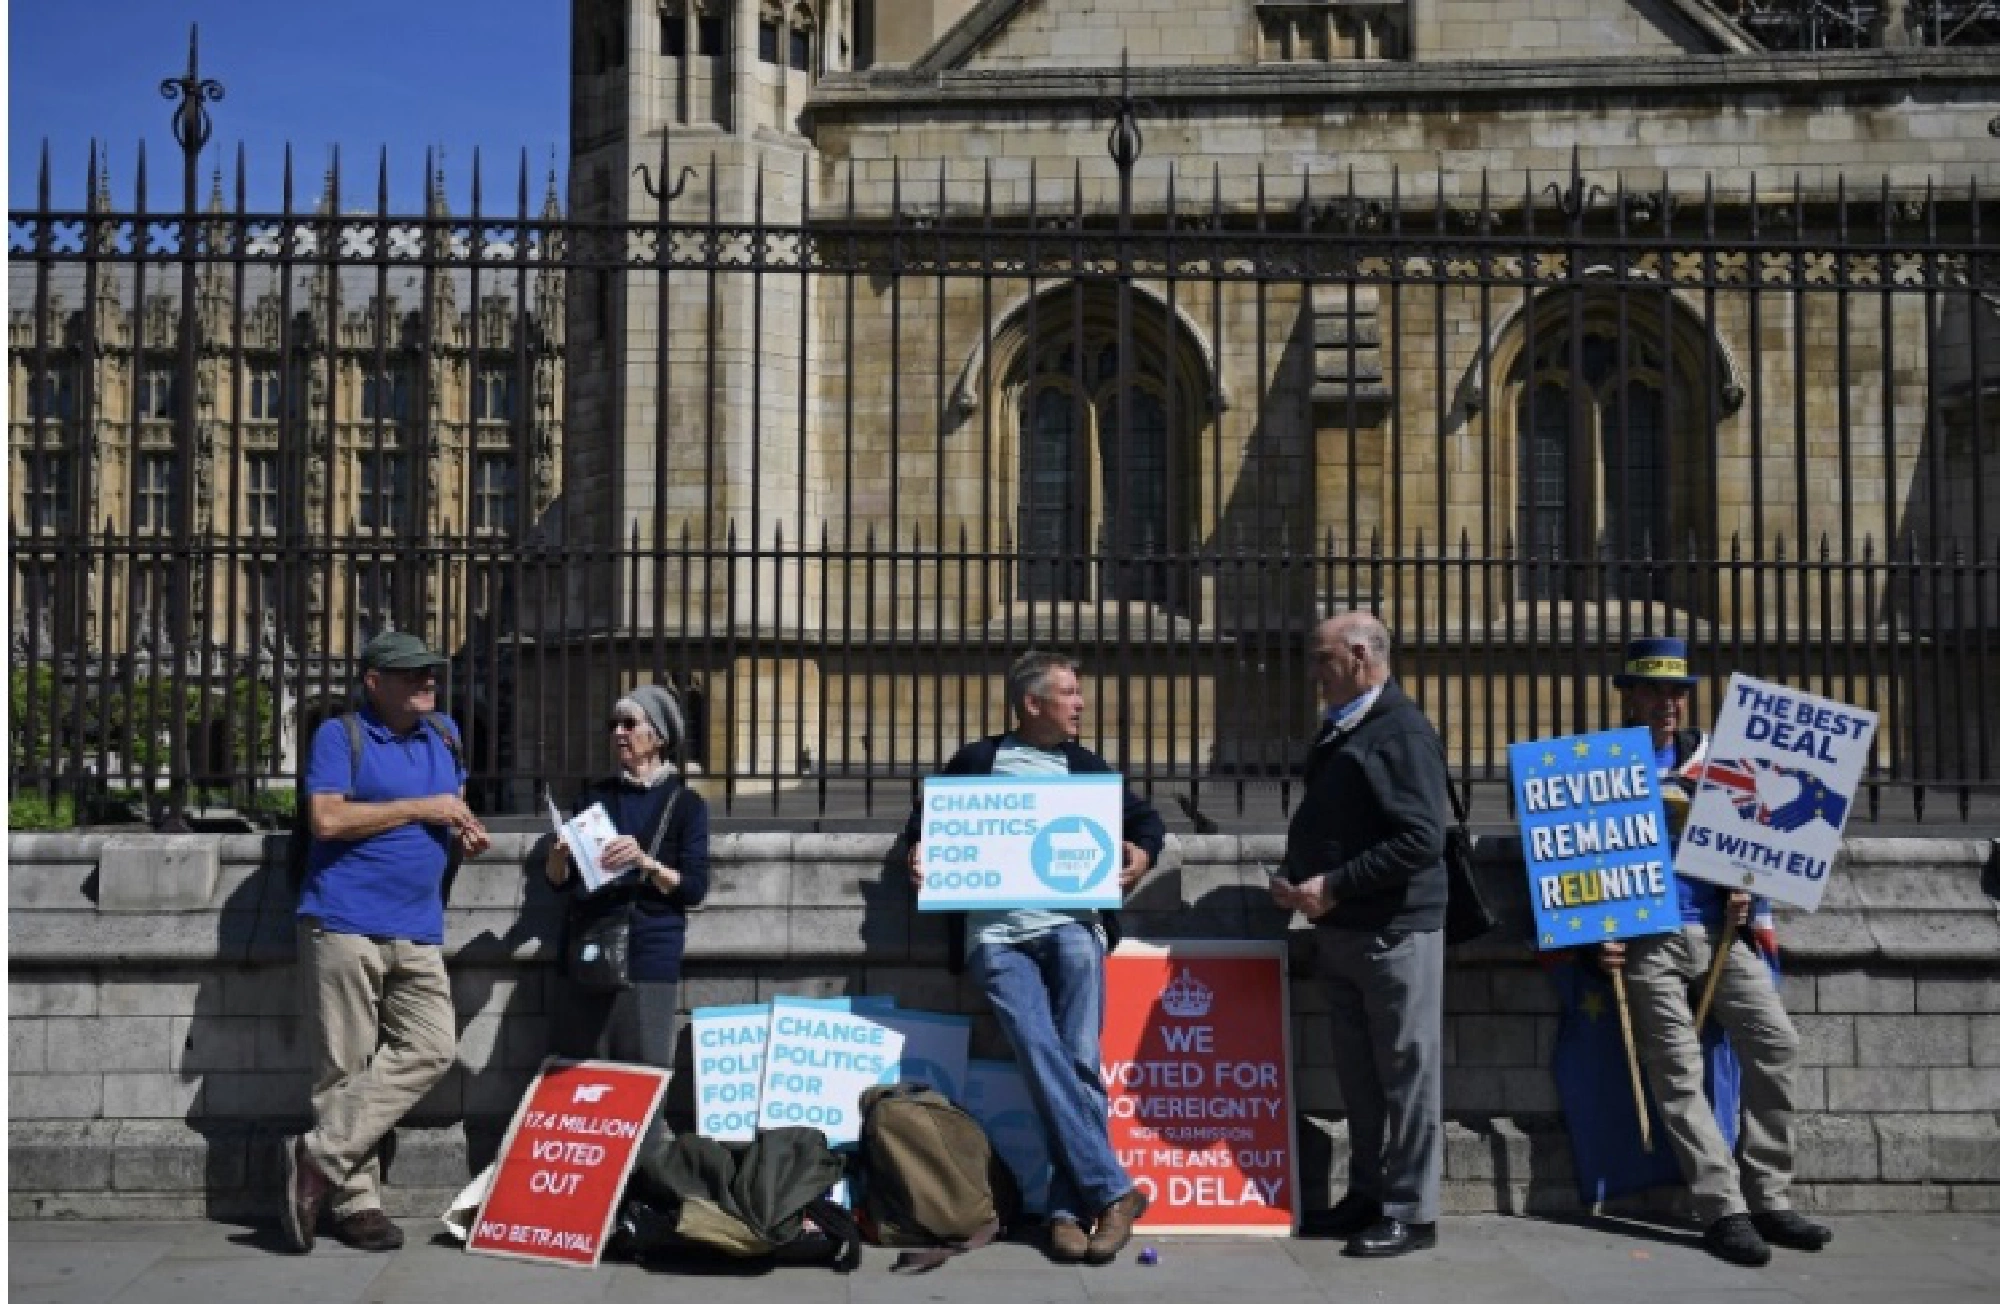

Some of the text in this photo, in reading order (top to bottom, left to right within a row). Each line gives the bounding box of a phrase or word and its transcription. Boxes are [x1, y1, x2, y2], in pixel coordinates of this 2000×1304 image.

[1735, 683, 1870, 741] THE BEST
[1745, 714, 1838, 764] DEAL
[1523, 763, 1650, 812] REVOKE
[930, 793, 1037, 812] CHANGE
[928, 819, 1038, 836] POLITICS
[1530, 811, 1660, 862] REMAIN
[928, 845, 979, 863] FOR
[1686, 824, 1714, 848] IS
[1715, 832, 1784, 869] WITH
[1786, 853, 1828, 883] EU
[926, 870, 1001, 889] GOOD
[1539, 861, 1666, 909] REUNITE
[700, 1026, 768, 1047] CHAN
[777, 1016, 886, 1046] CHANGE
[1159, 1025, 1215, 1053] WE
[701, 1052, 767, 1076] POLI
[773, 1043, 883, 1075] POLITICS
[769, 1071, 823, 1095] FOR
[1099, 1059, 1278, 1089] VOTED FOR
[703, 1082, 756, 1106] FOR
[557, 1113, 638, 1139] MILLION
[704, 1111, 758, 1134] GOO
[767, 1100, 843, 1126] GOOD
[532, 1140, 606, 1166] VOTED
[1116, 1149, 1286, 1168] UT MEANS OUT
[530, 1170, 585, 1195] OUT
[1166, 1175, 1284, 1207] DELAY
[478, 1220, 593, 1254] NO BETRAYAL
